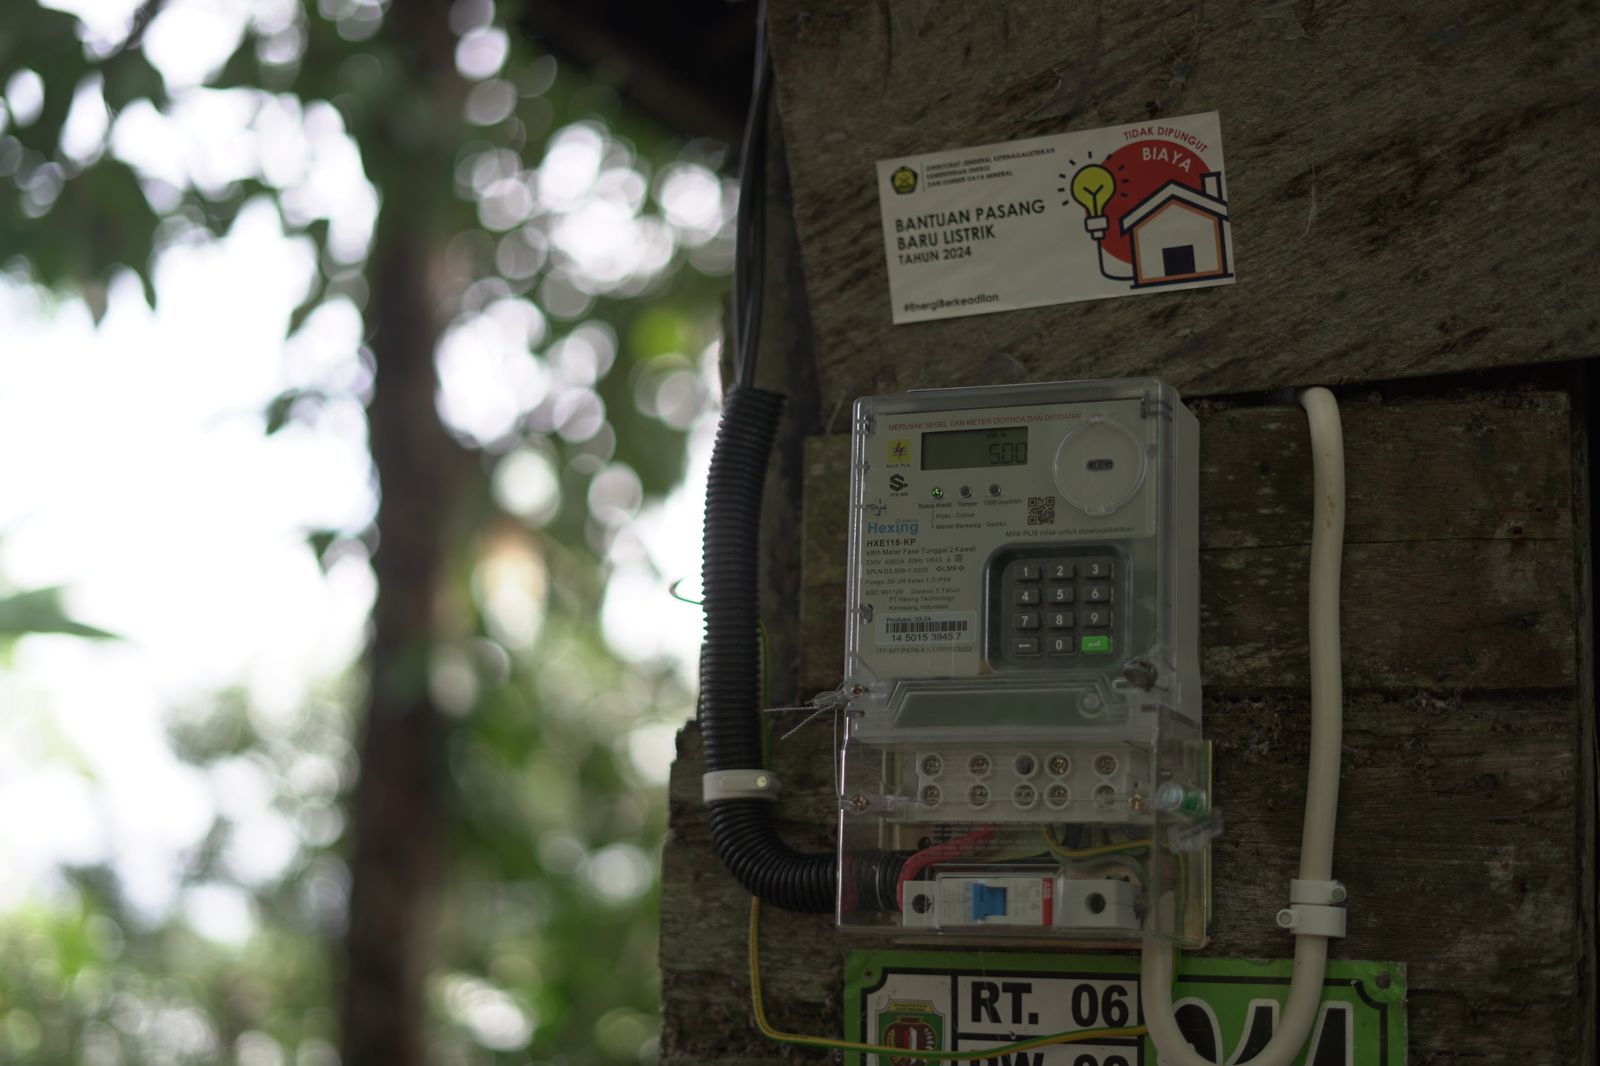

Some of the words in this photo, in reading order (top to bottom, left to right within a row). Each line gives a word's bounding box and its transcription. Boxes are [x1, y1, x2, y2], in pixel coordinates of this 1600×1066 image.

[1124, 127, 1154, 140] TIDAK
[1158, 127, 1208, 152] DIPUNGUT
[1142, 147, 1192, 173] BIAYA
[895, 208, 971, 232] BANTUAN
[976, 200, 1045, 222] PASANG
[897, 233, 938, 250] BARU
[944, 225, 996, 244] LISTRIK
[898, 250, 939, 266] TAHUN
[943, 246, 972, 260] 2024
[904, 294, 999, 312] #EnergiBerkeadilan
[888, 423, 924, 432] MERUSAK
[988, 442, 1028, 465] 500
[868, 522, 918, 535] Hexing
[867, 538, 916, 547] HXE118-KP
[922, 547, 948, 555] Tunggal
[1023, 566, 1028, 576] 1
[1056, 565, 1064, 576] 2
[1092, 564, 1099, 574] 3
[1022, 591, 1029, 600] 4
[1056, 589, 1064, 600] 5
[1092, 588, 1099, 599] 6
[1022, 616, 1028, 626] 7
[1056, 614, 1062, 625] 8
[1090, 612, 1098, 624] 9
[892, 634, 902, 642] 14
[905, 633, 928, 642] 5015
[1056, 640, 1062, 650] 0
[970, 982, 1040, 1025] RT.
[1071, 984, 1130, 1028] 06
